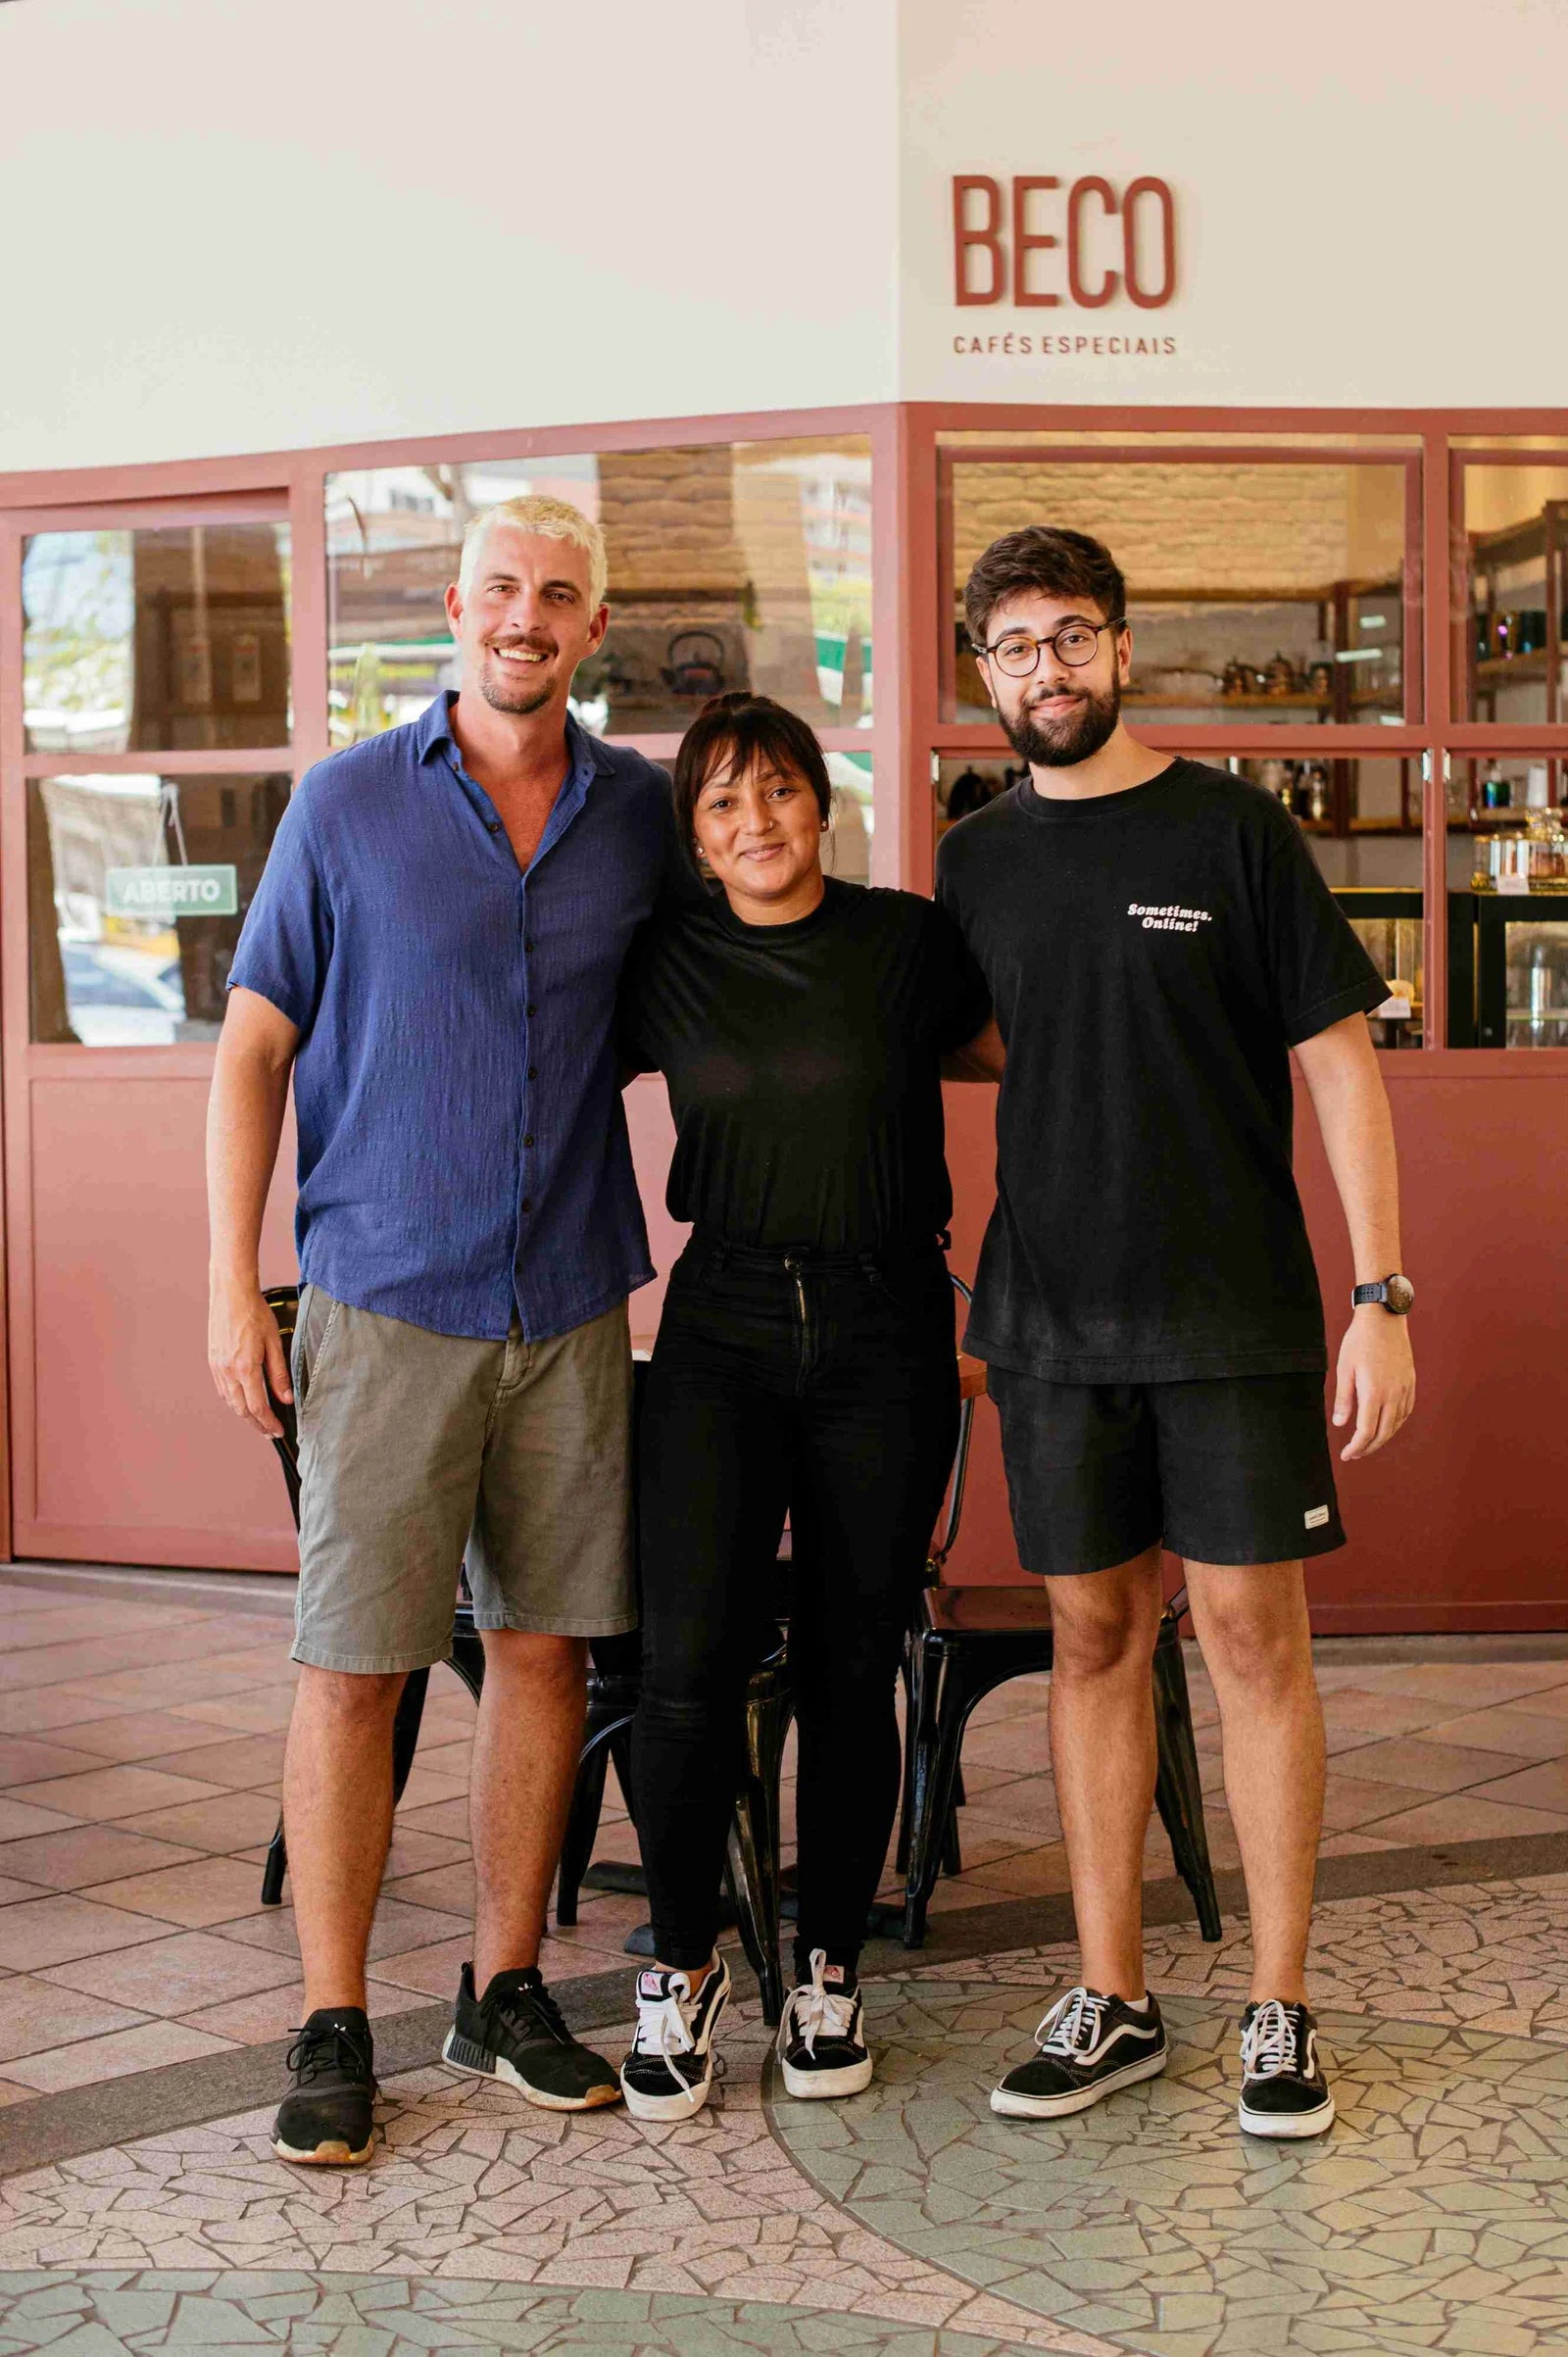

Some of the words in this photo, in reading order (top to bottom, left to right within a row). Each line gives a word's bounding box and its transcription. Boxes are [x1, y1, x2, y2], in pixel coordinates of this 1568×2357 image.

[953, 174, 1176, 309] BECO
[953, 332, 1032, 355] CAFÉS
[1043, 336, 1177, 355] ESPECIAIS
[123, 879, 220, 903] ABERTO
[1127, 903, 1212, 921] Sometimes.
[1142, 916, 1199, 932] Online!
